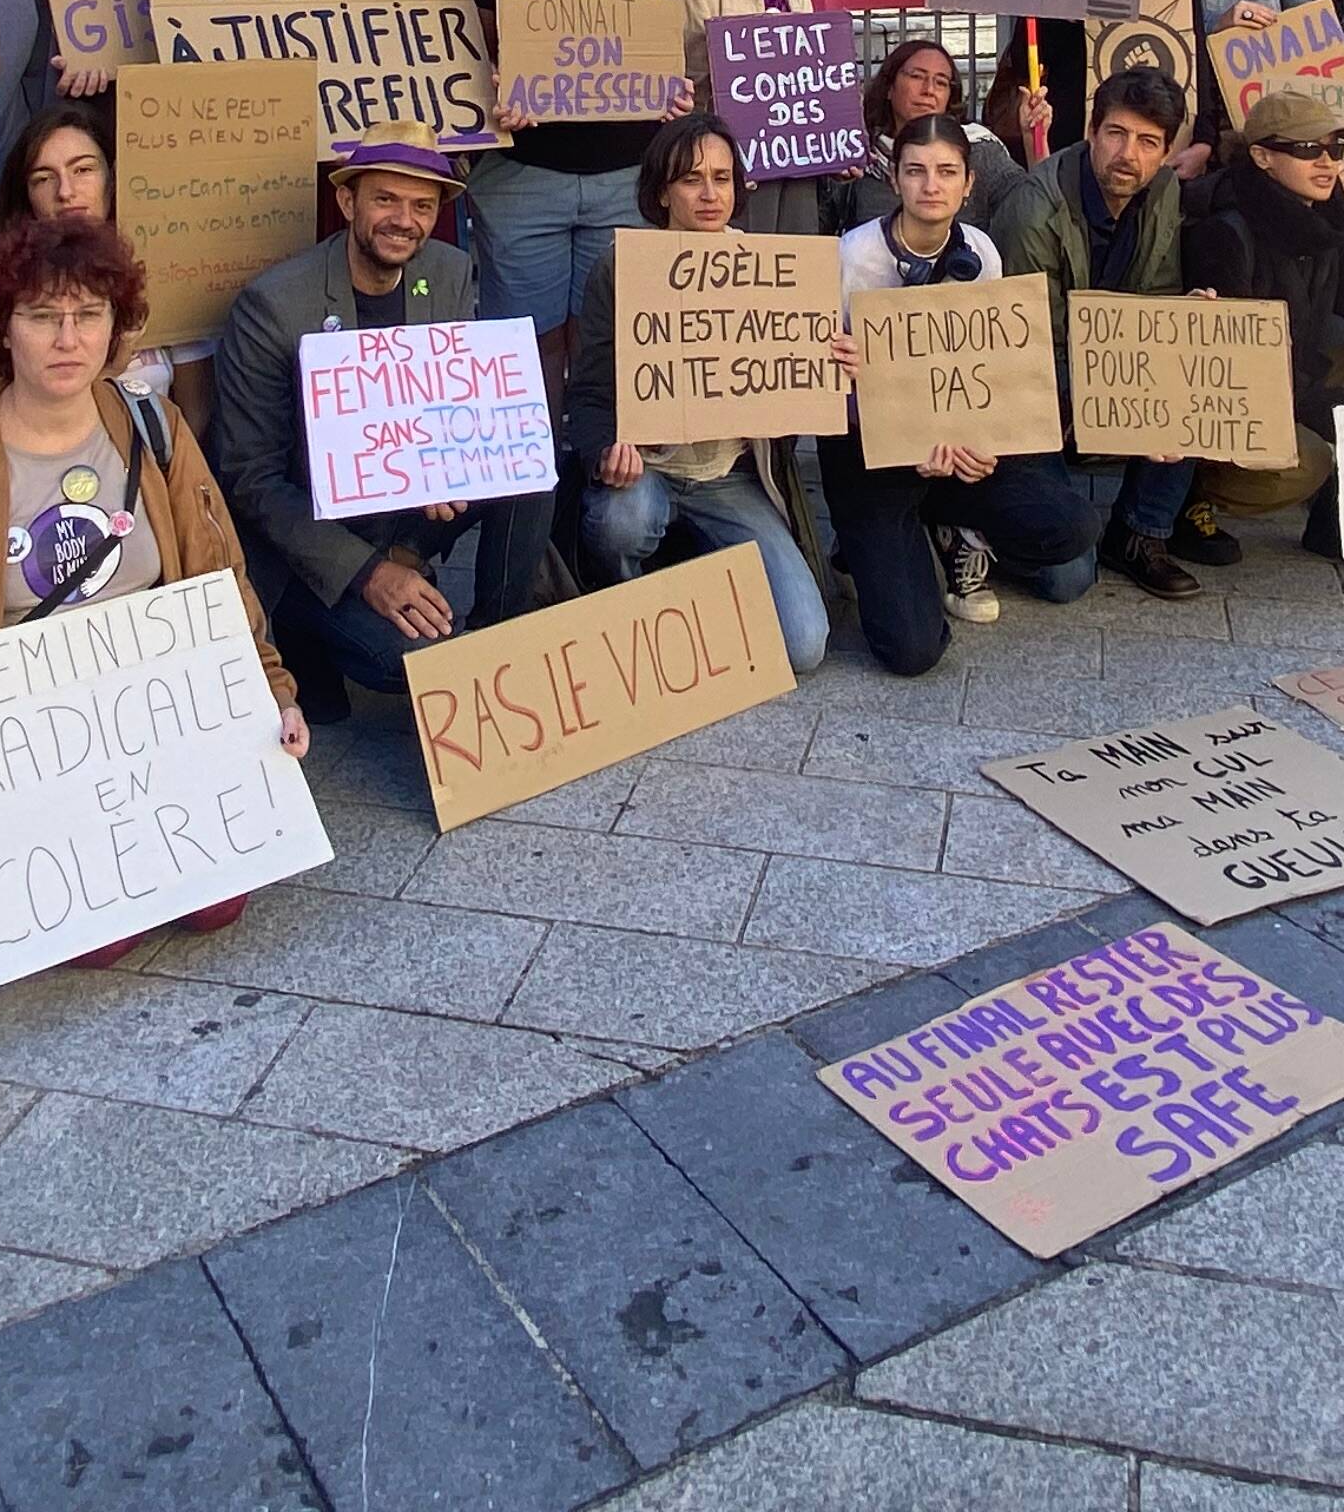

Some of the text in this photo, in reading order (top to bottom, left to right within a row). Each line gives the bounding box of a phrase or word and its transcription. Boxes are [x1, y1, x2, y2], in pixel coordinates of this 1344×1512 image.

[555, 35, 623, 67] SON
[768, 99, 825, 126] DES
[668, 243, 797, 292] GISÈLE
[359, 325, 472, 362] PAS DE
[864, 303, 1029, 364] M'ENDORS
[1078, 307, 1283, 347] 90% DES PLAINTES
[310, 354, 528, 420] FÉMINISME
[930, 363, 992, 413] PAS
[1085, 349, 1249, 390] POUR VIOL
[363, 402, 551, 452] SANS TOUTES
[1189, 393, 1250, 417] SANS
[1179, 416, 1267, 452] SUITE
[327, 442, 548, 505] LES FEMMES
[55, 537, 87, 564] BODY
[56, 519, 75, 539] MY
[417, 598, 731, 785] RAS LE VIOL
[94, 760, 152, 815] EN
[1118, 751, 1274, 800] mon CUL
[1120, 776, 1288, 838] ma MAIN
[1192, 807, 1337, 858] dans ta
[842, 930, 1200, 1100] AU FINAL RESTER
[889, 962, 1261, 1142] SEULE AVEC DES
[944, 991, 1325, 1183] CHATS EST PLUS
[1115, 1066, 1301, 1184] SAFE
